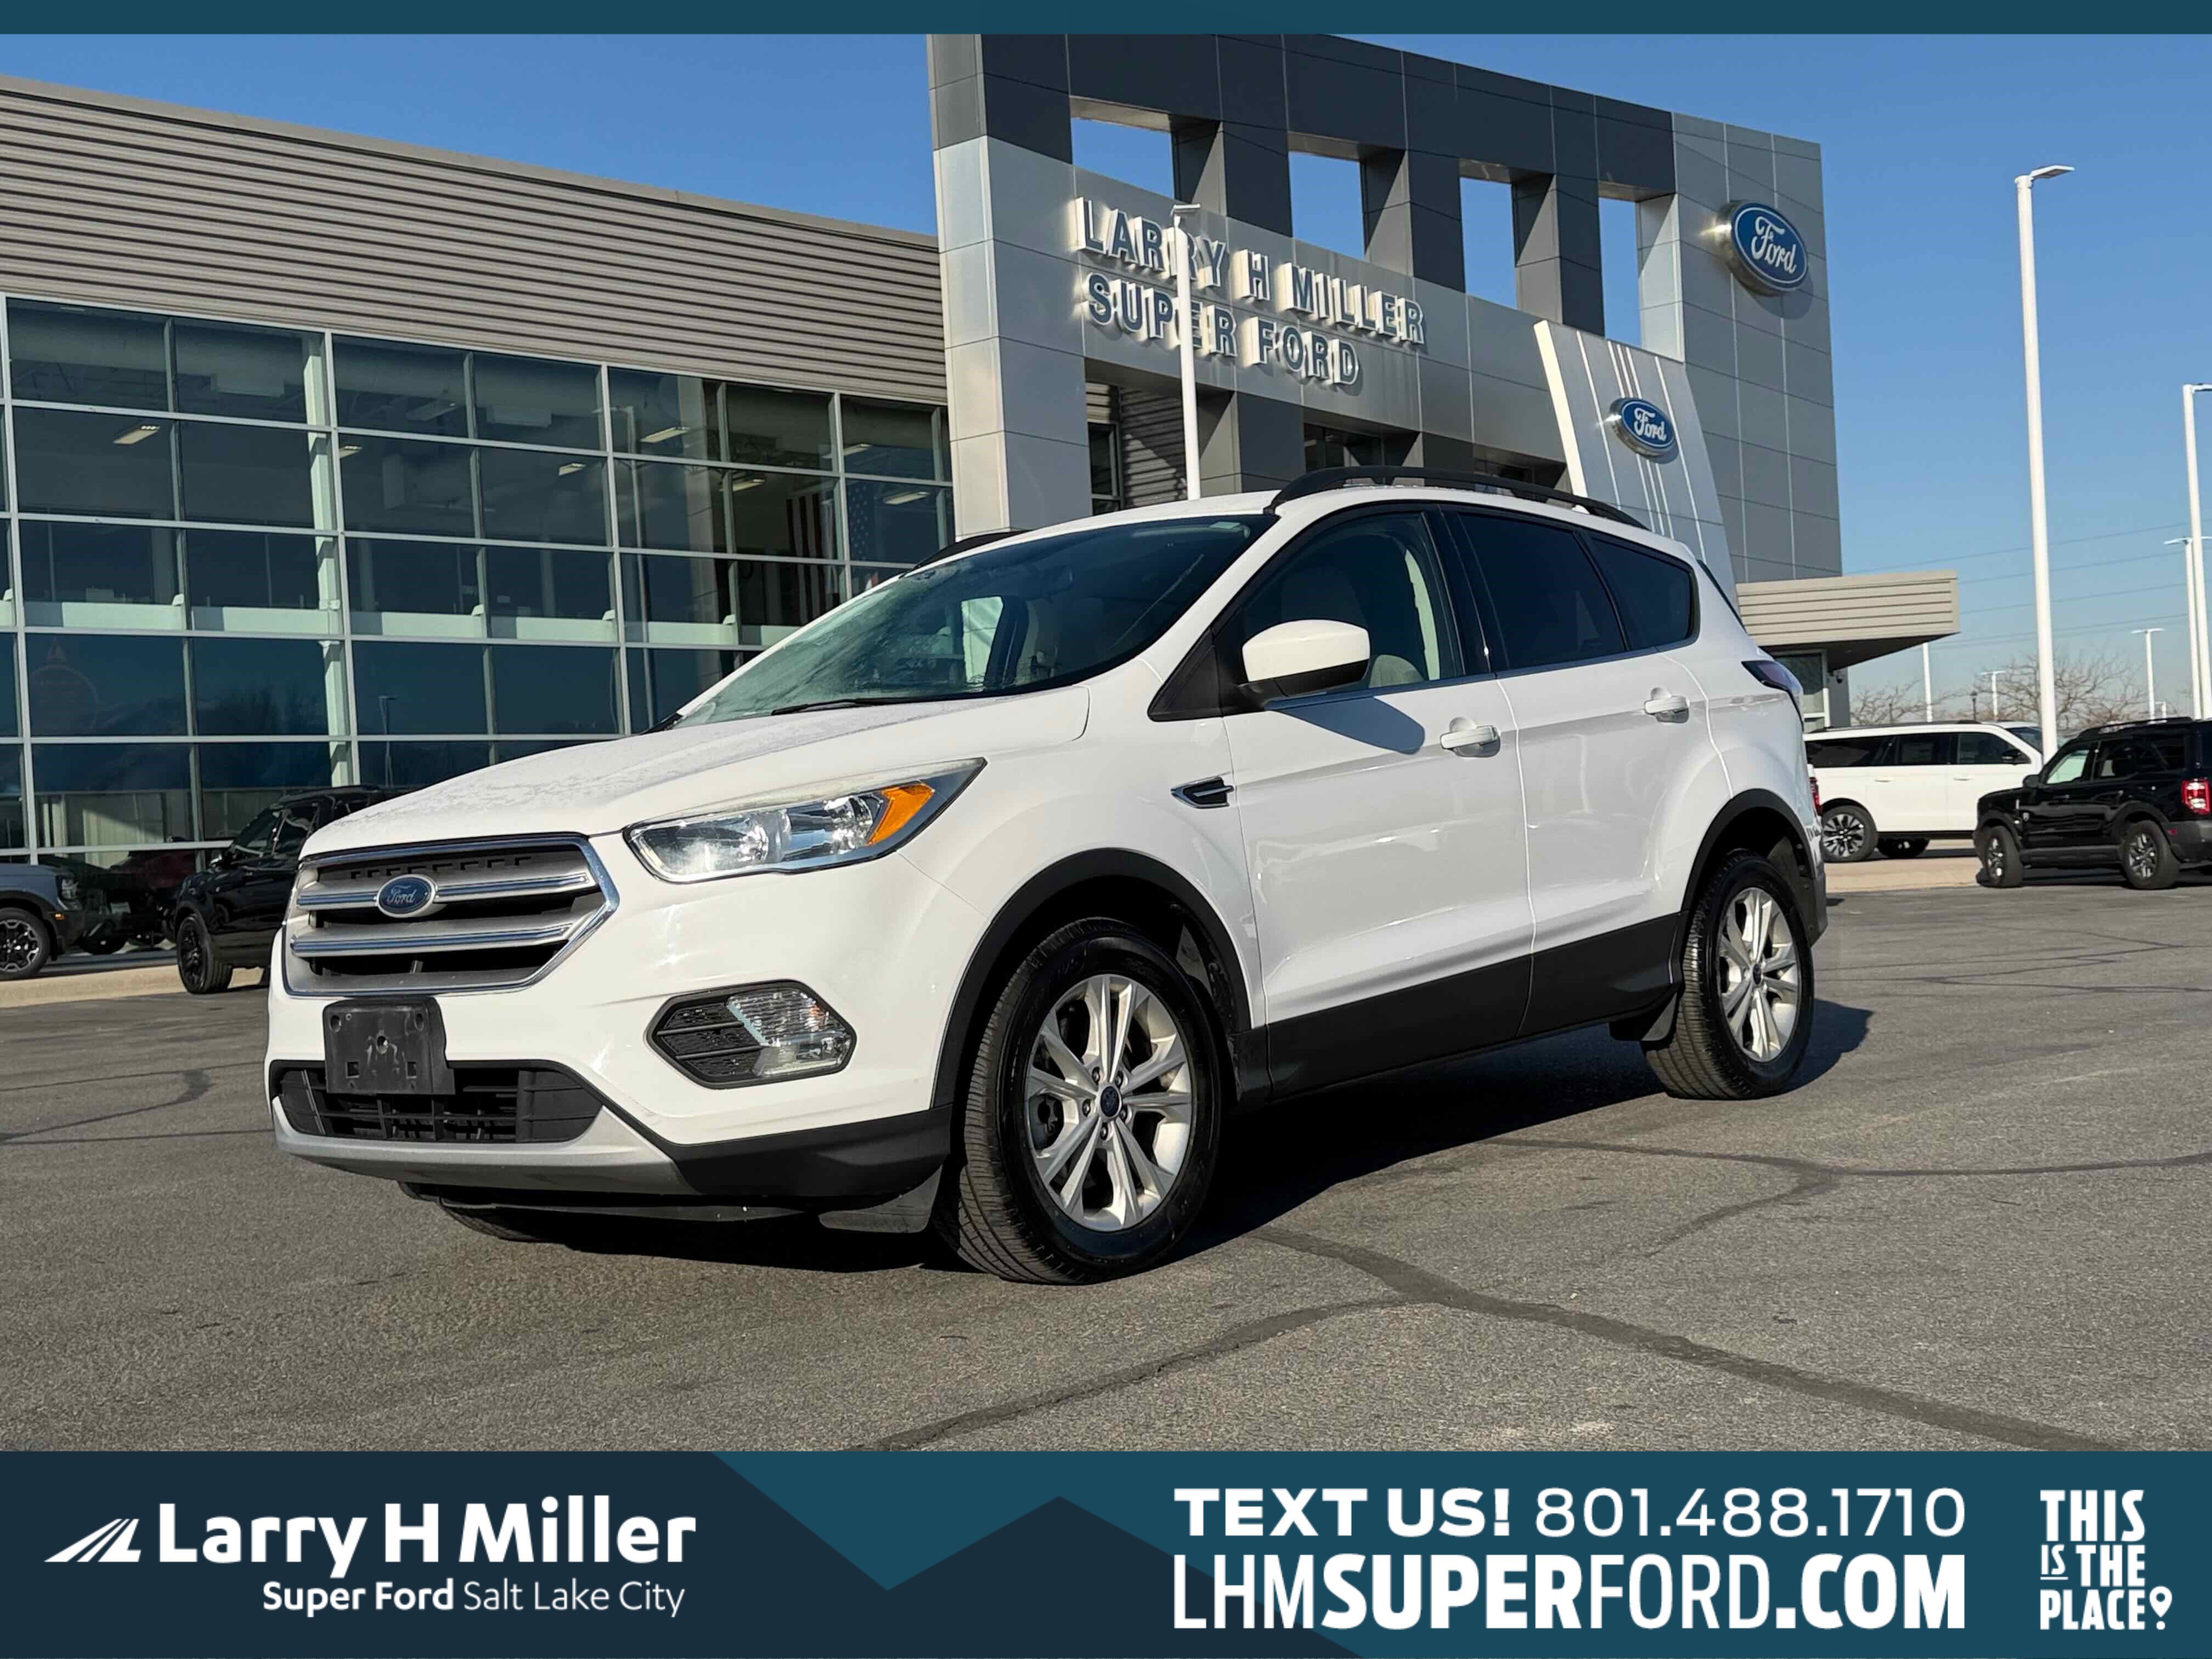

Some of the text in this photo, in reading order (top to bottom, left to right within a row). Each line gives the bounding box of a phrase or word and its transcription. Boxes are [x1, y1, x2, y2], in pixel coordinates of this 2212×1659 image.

[1751, 216, 1798, 275] Ford
[1244, 249, 1271, 301] H
[1285, 262, 1425, 345] MILLER
[1253, 316, 1361, 386] FORD
[1633, 406, 1668, 441] Ford
[386, 884, 417, 905] Ford
